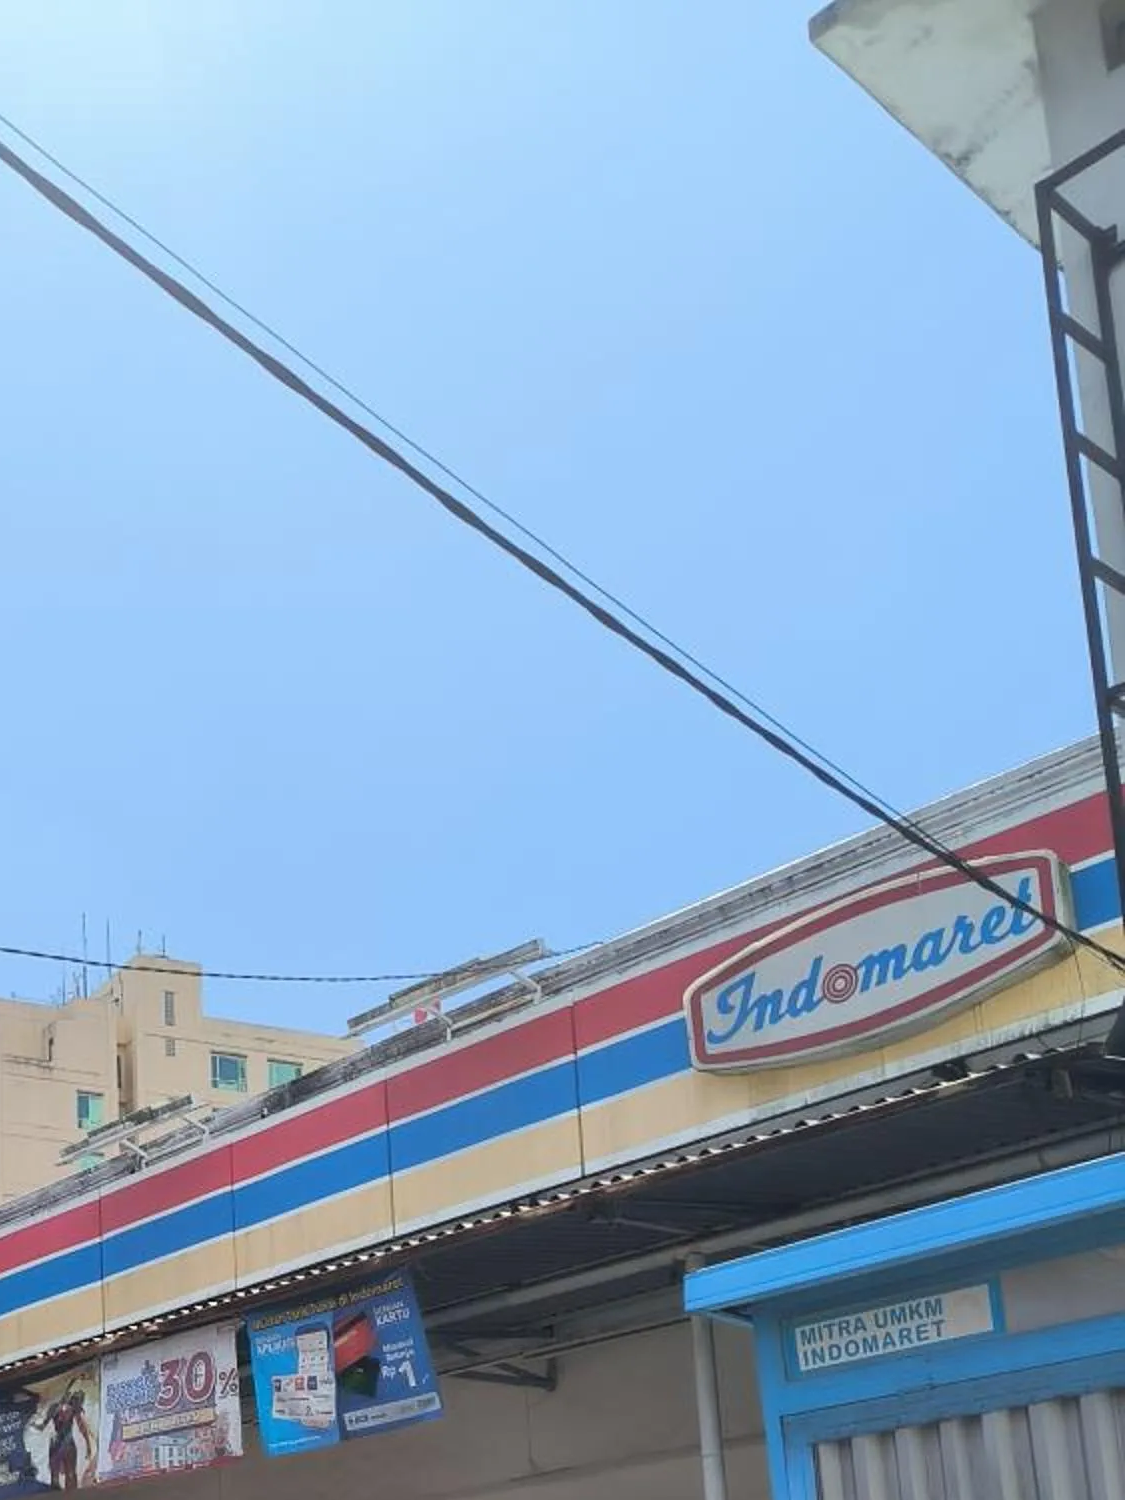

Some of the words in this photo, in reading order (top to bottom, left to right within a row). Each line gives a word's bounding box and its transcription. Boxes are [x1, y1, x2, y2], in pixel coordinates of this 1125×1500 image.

[707, 877, 1038, 1045] Indomaret
[377, 1307, 410, 1327] KARTU
[800, 1317, 866, 1347] MITRA
[874, 1297, 944, 1330] UMKM
[800, 1319, 947, 1369] INDOMARET
